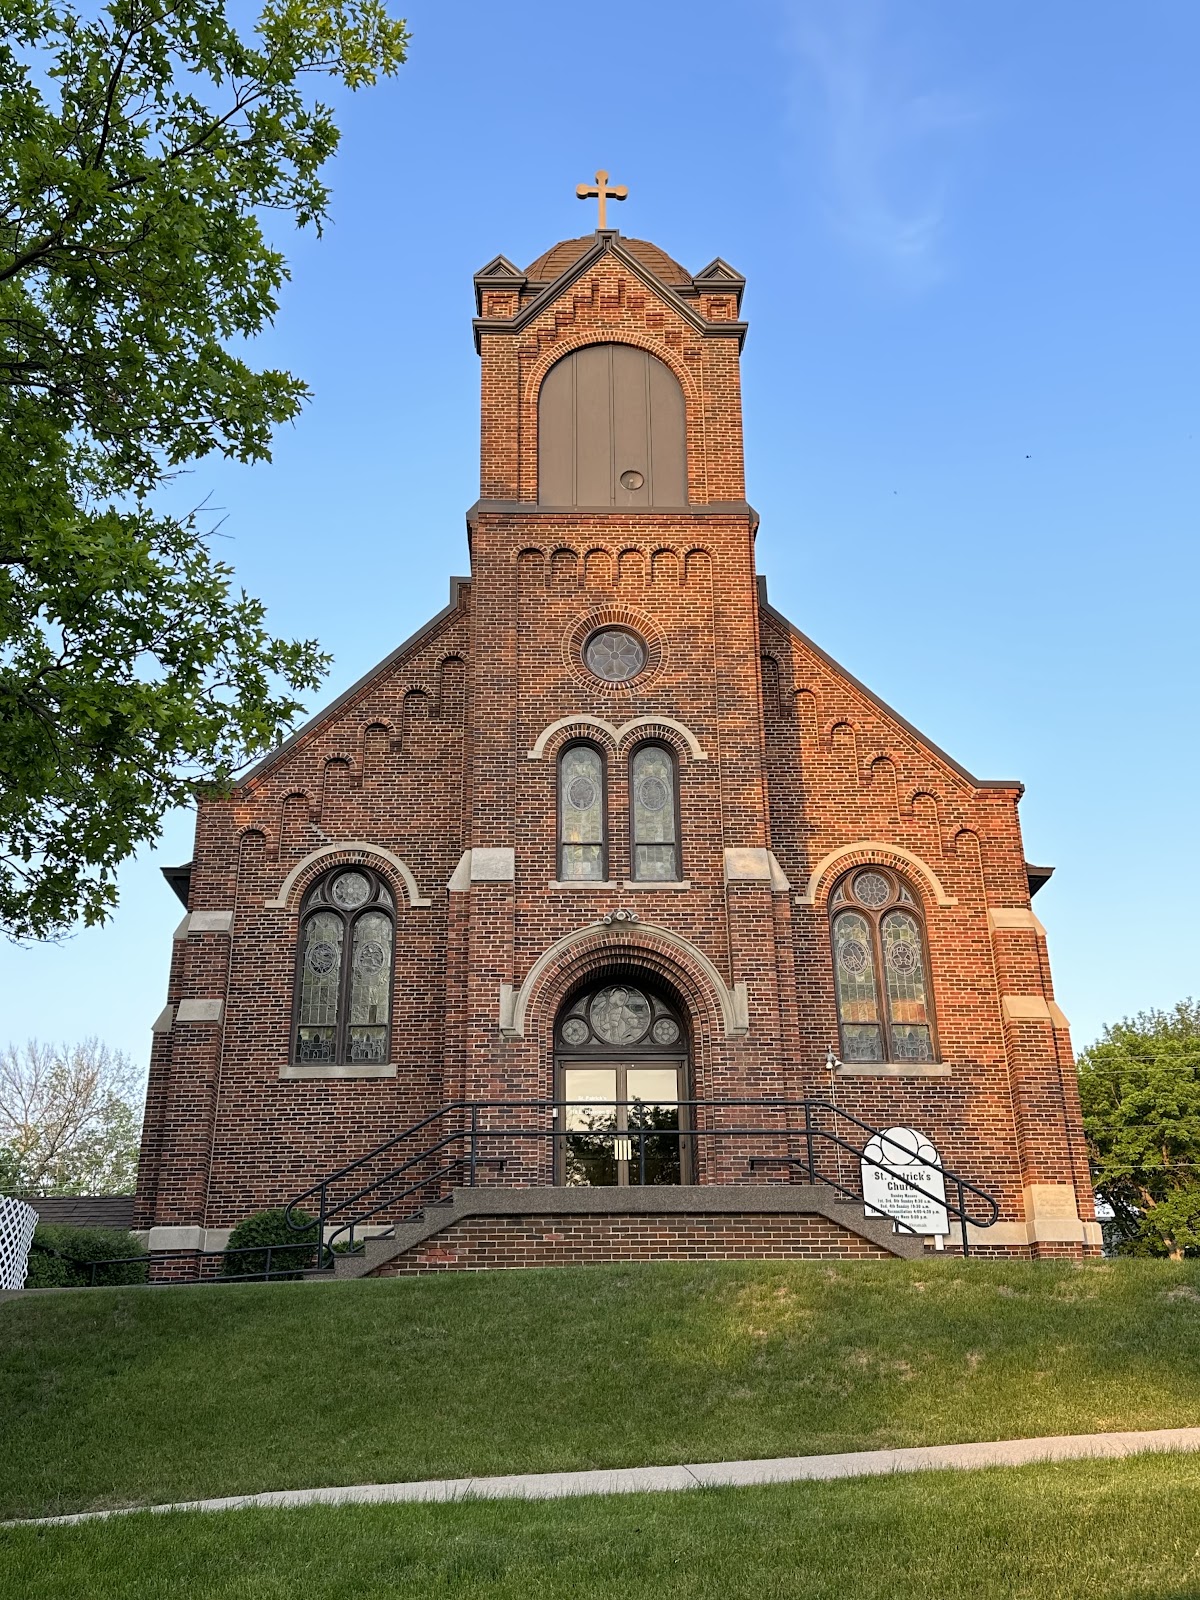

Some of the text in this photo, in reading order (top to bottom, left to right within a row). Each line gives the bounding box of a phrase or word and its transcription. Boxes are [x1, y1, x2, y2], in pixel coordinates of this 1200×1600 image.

[874, 1170, 931, 1180] St. trick's
[887, 1182, 919, 1190] Churc
